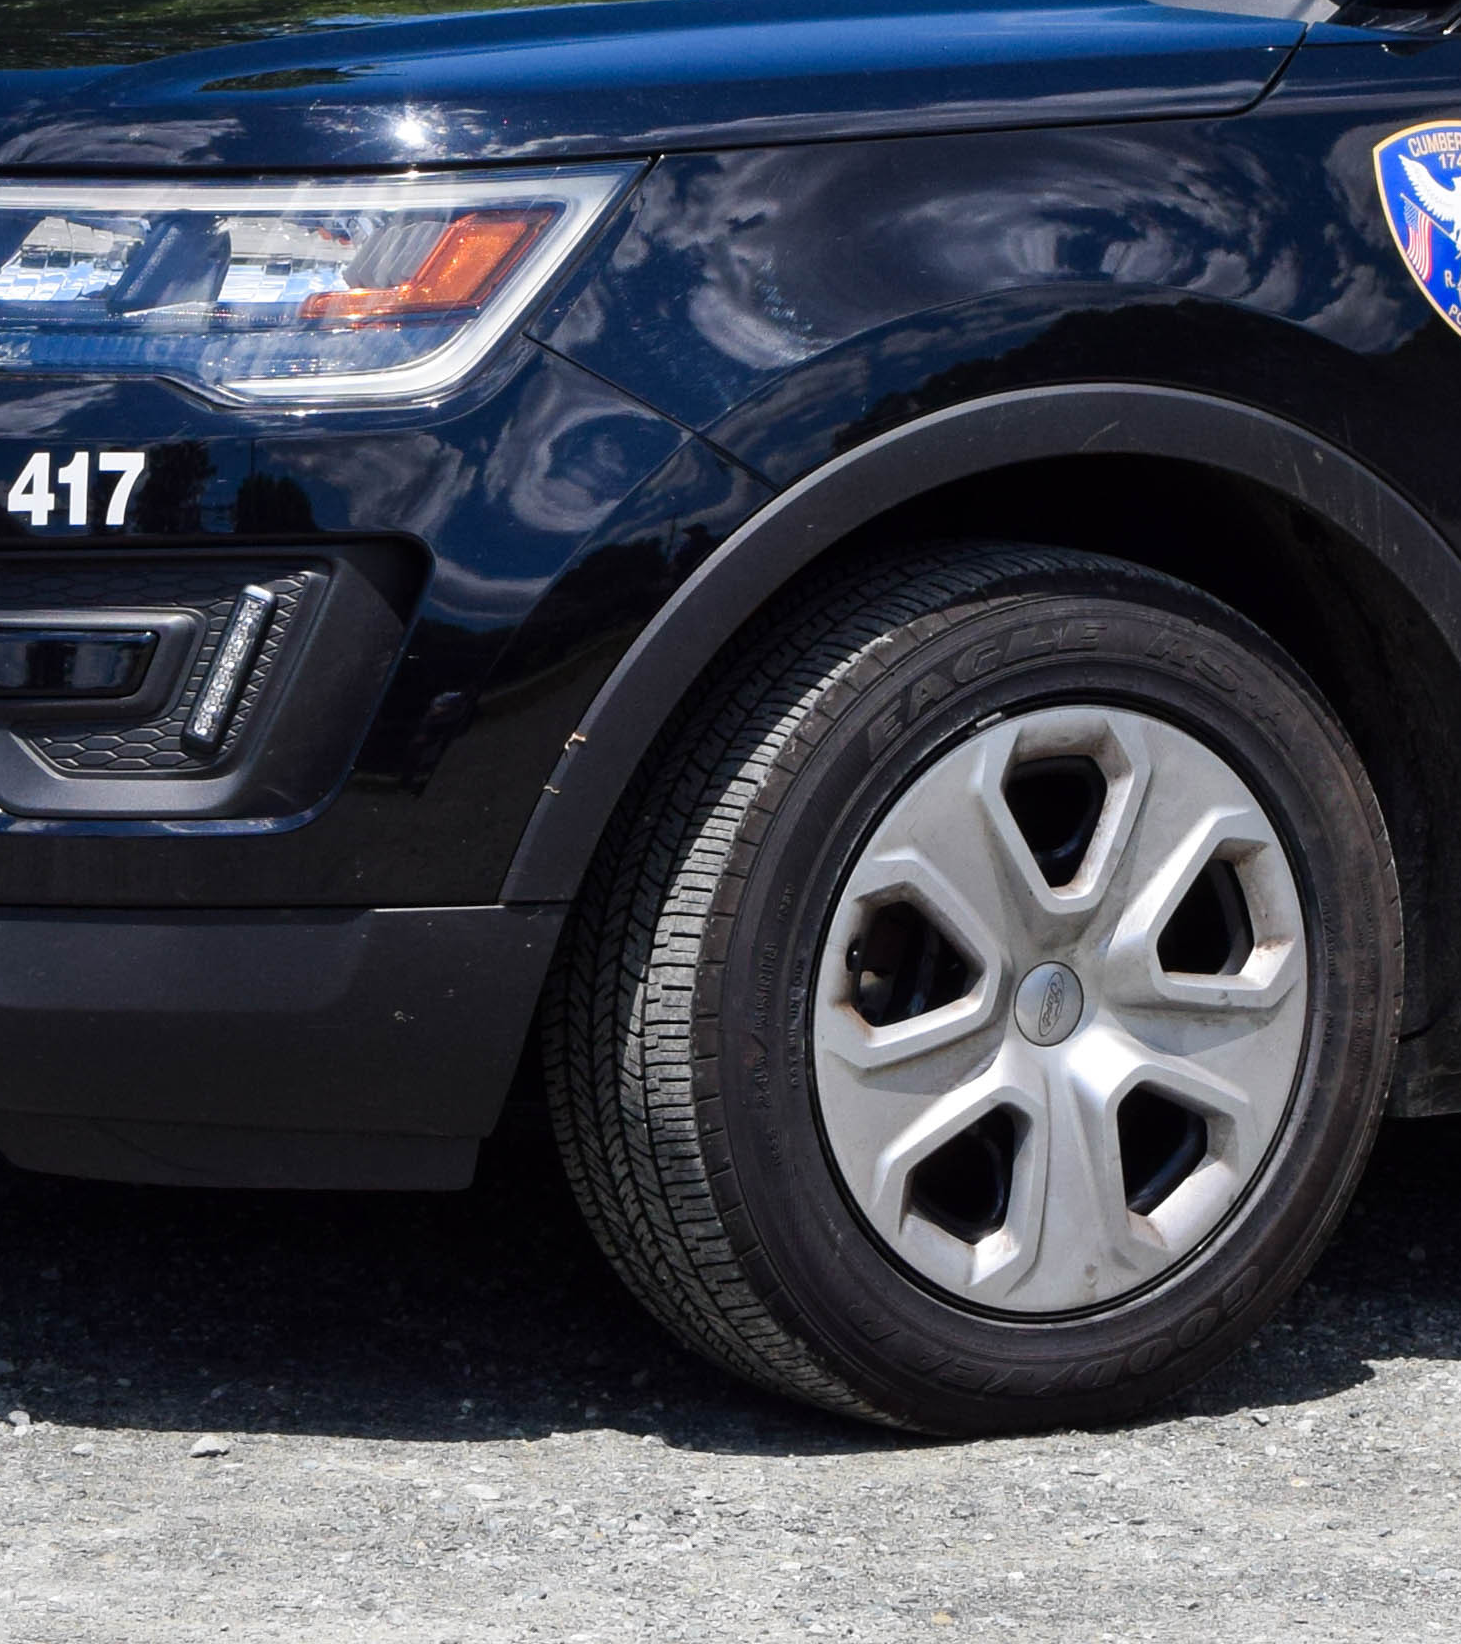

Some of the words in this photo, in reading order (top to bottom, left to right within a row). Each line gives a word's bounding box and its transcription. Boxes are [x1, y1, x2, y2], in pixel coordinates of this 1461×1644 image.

[7, 451, 145, 525] 417
[869, 619, 1107, 752] EAGLE
[848, 1266, 1260, 1397] GOODYEAR
